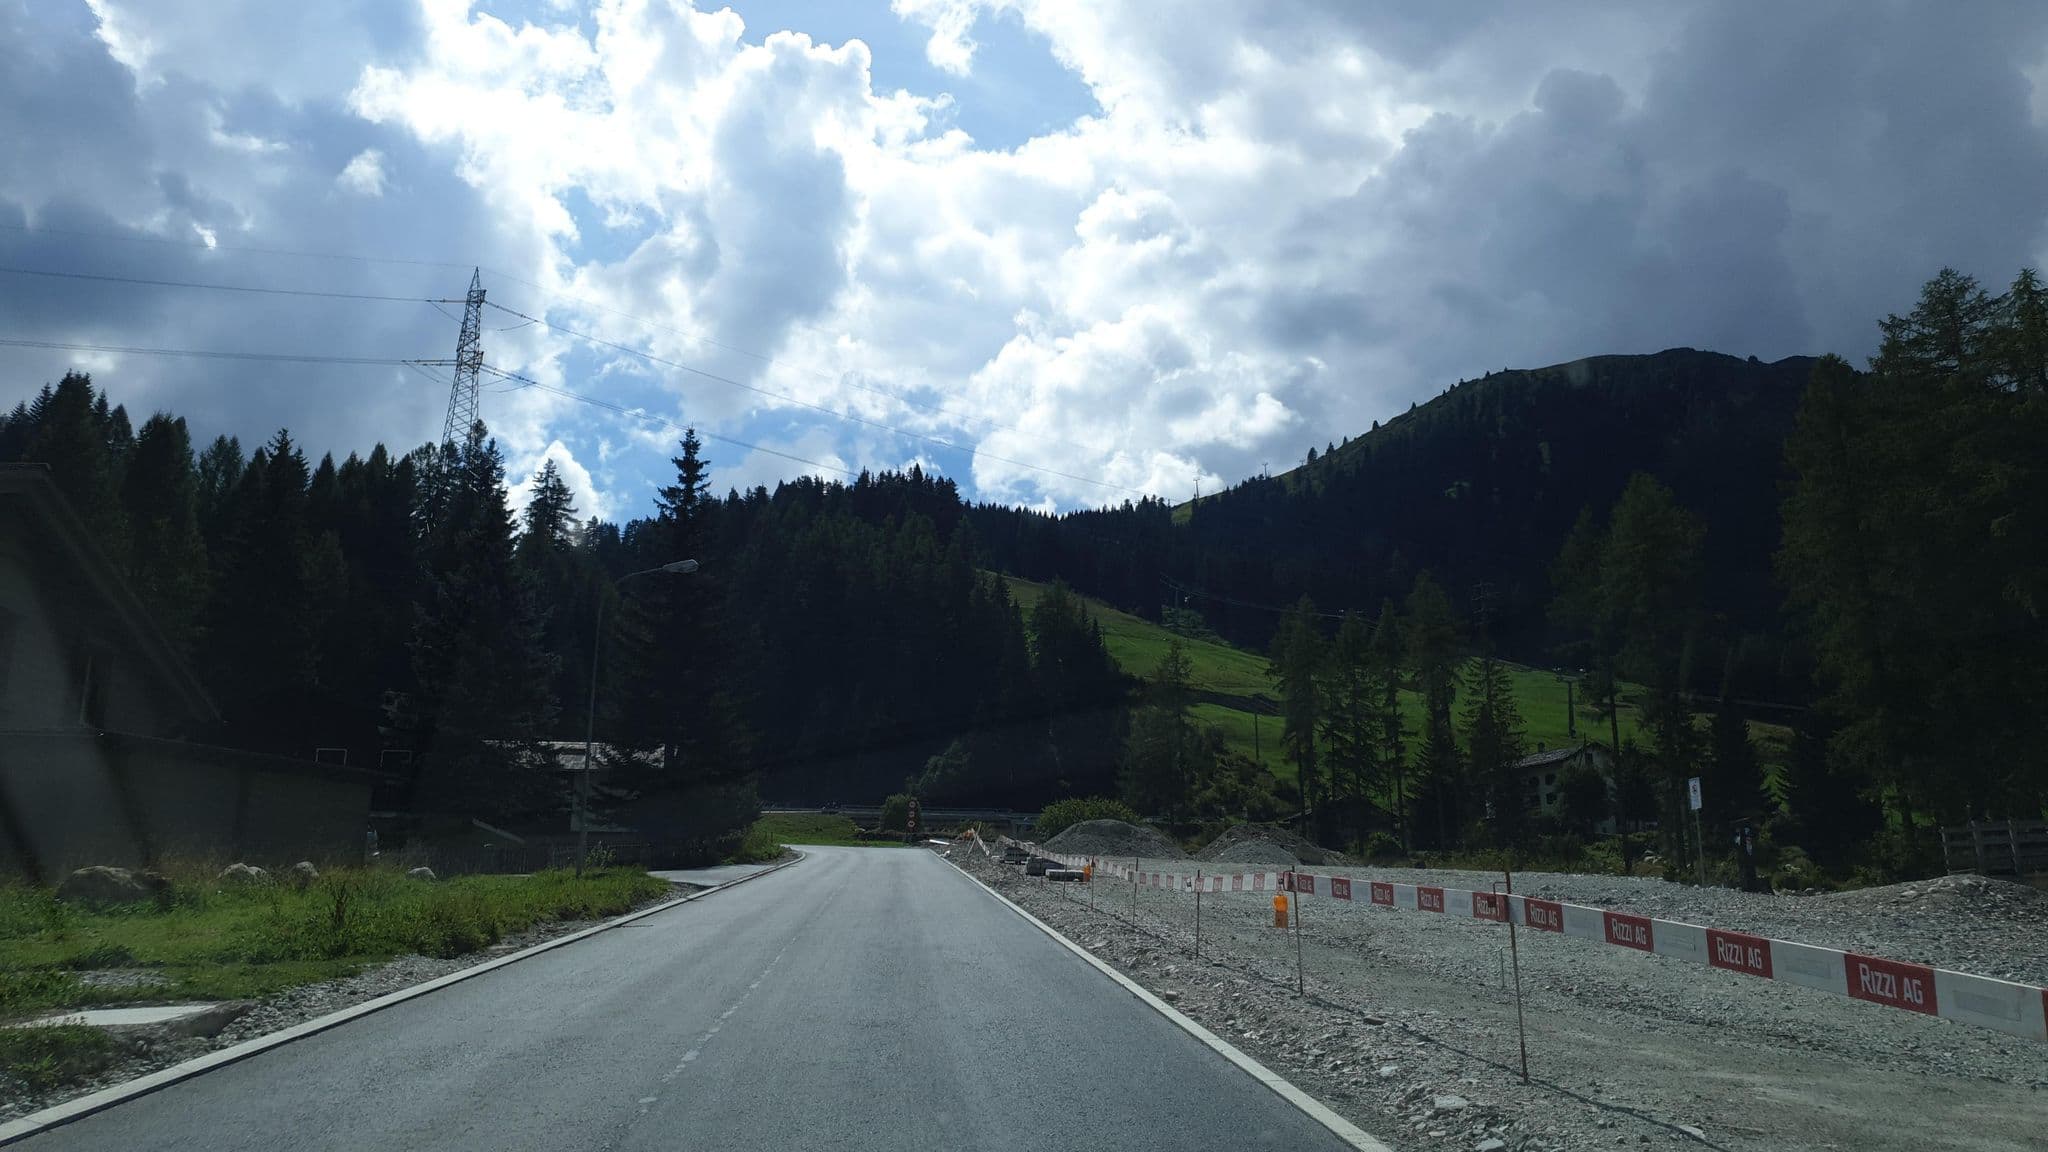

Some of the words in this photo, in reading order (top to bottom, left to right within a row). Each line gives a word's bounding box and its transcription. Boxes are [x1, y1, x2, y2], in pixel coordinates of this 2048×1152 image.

[1530, 904, 1547, 925] RIZZI
[1548, 911, 1558, 927] AG
[1611, 918, 1633, 942] RIZZI
[1635, 926, 1647, 945] AG
[1716, 937, 1744, 965] RIZZI
[1748, 947, 1763, 969] AG
[1858, 963, 1898, 999] RIZZI
[1903, 978, 1924, 1005] AG
